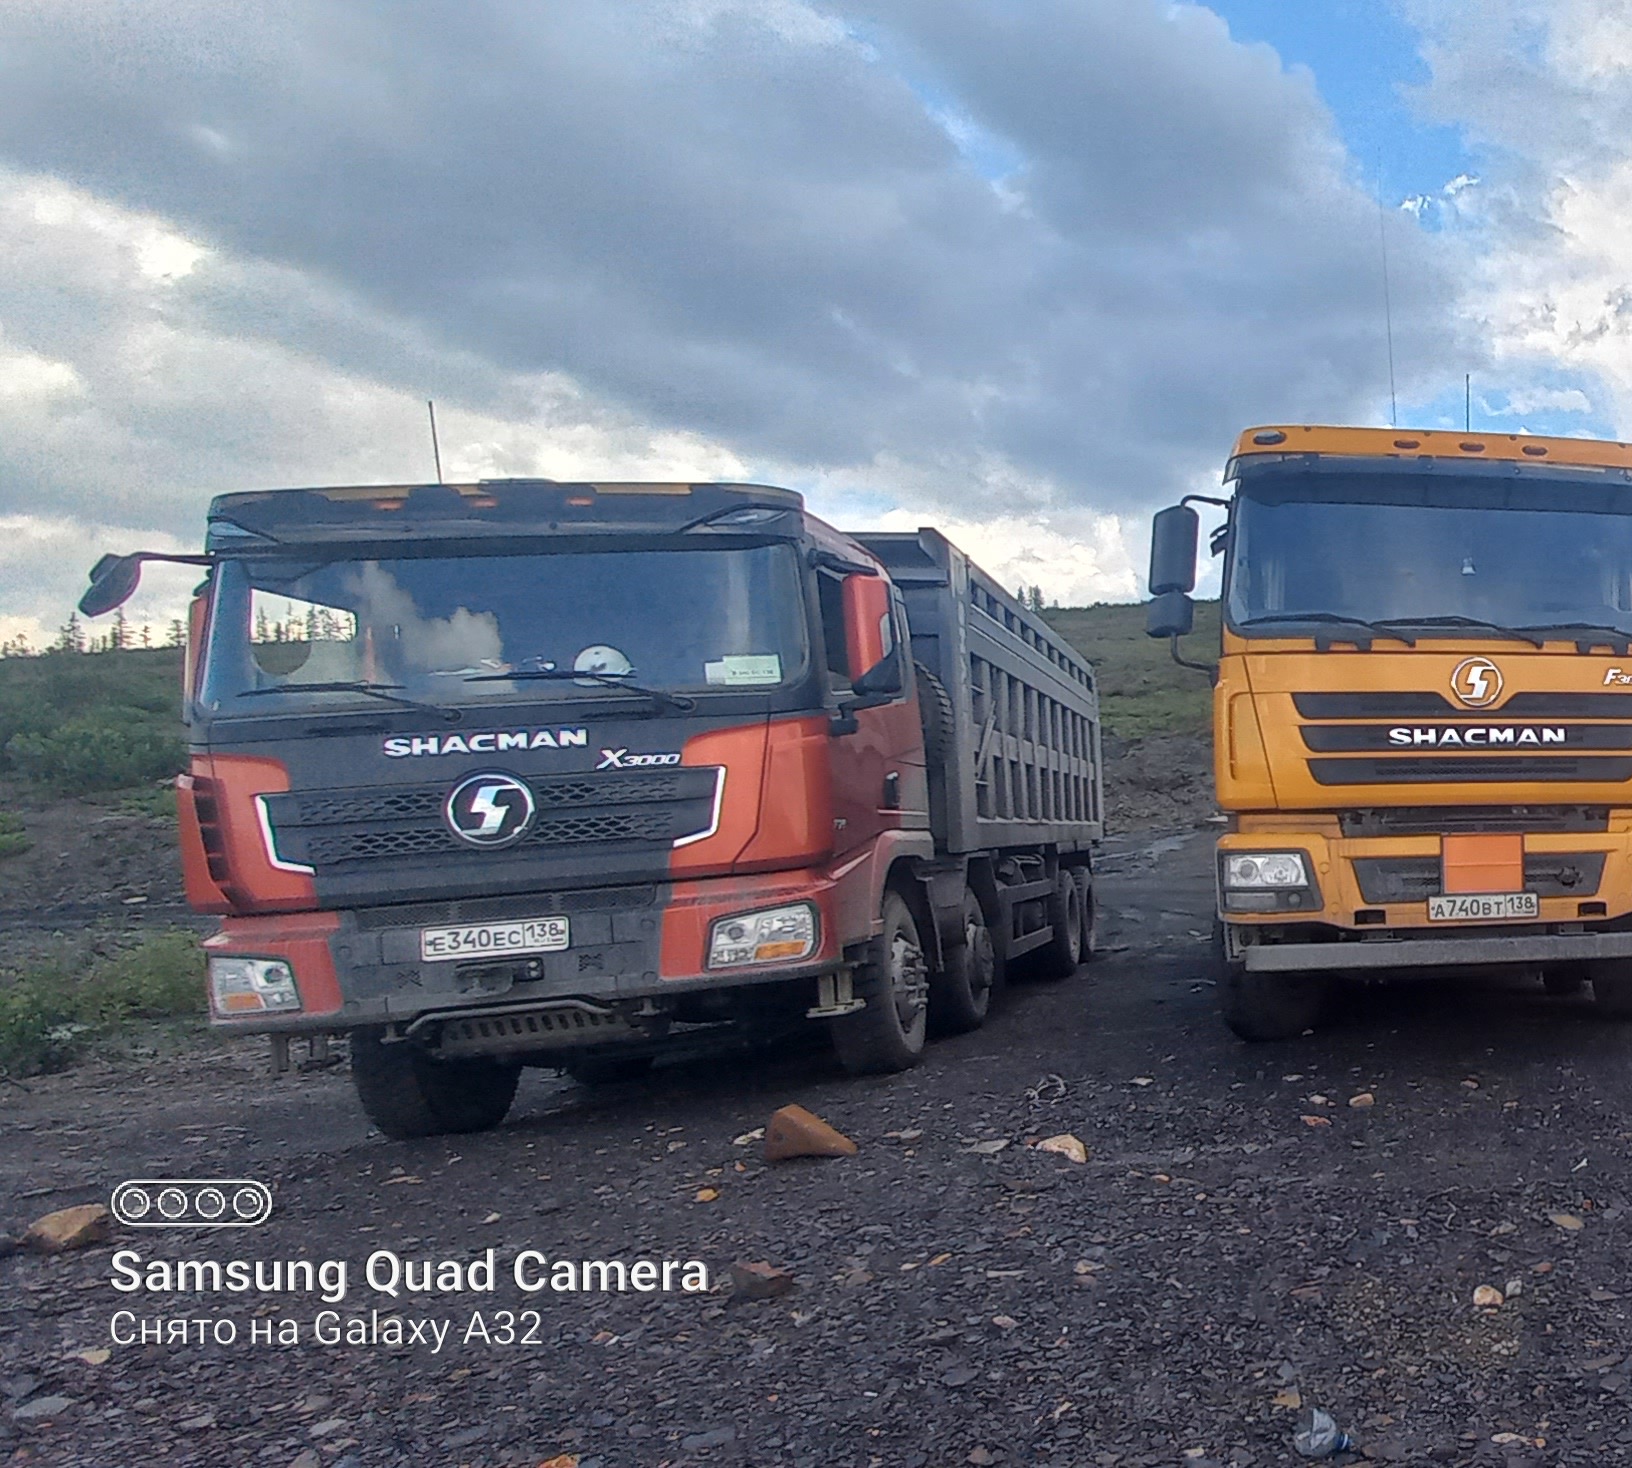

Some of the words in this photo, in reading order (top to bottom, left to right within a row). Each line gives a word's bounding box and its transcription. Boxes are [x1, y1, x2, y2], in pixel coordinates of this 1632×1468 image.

[384, 728, 588, 757] SHACMAN
[1388, 727, 1566, 747] SHACMAN
[595, 748, 681, 769] X3000
